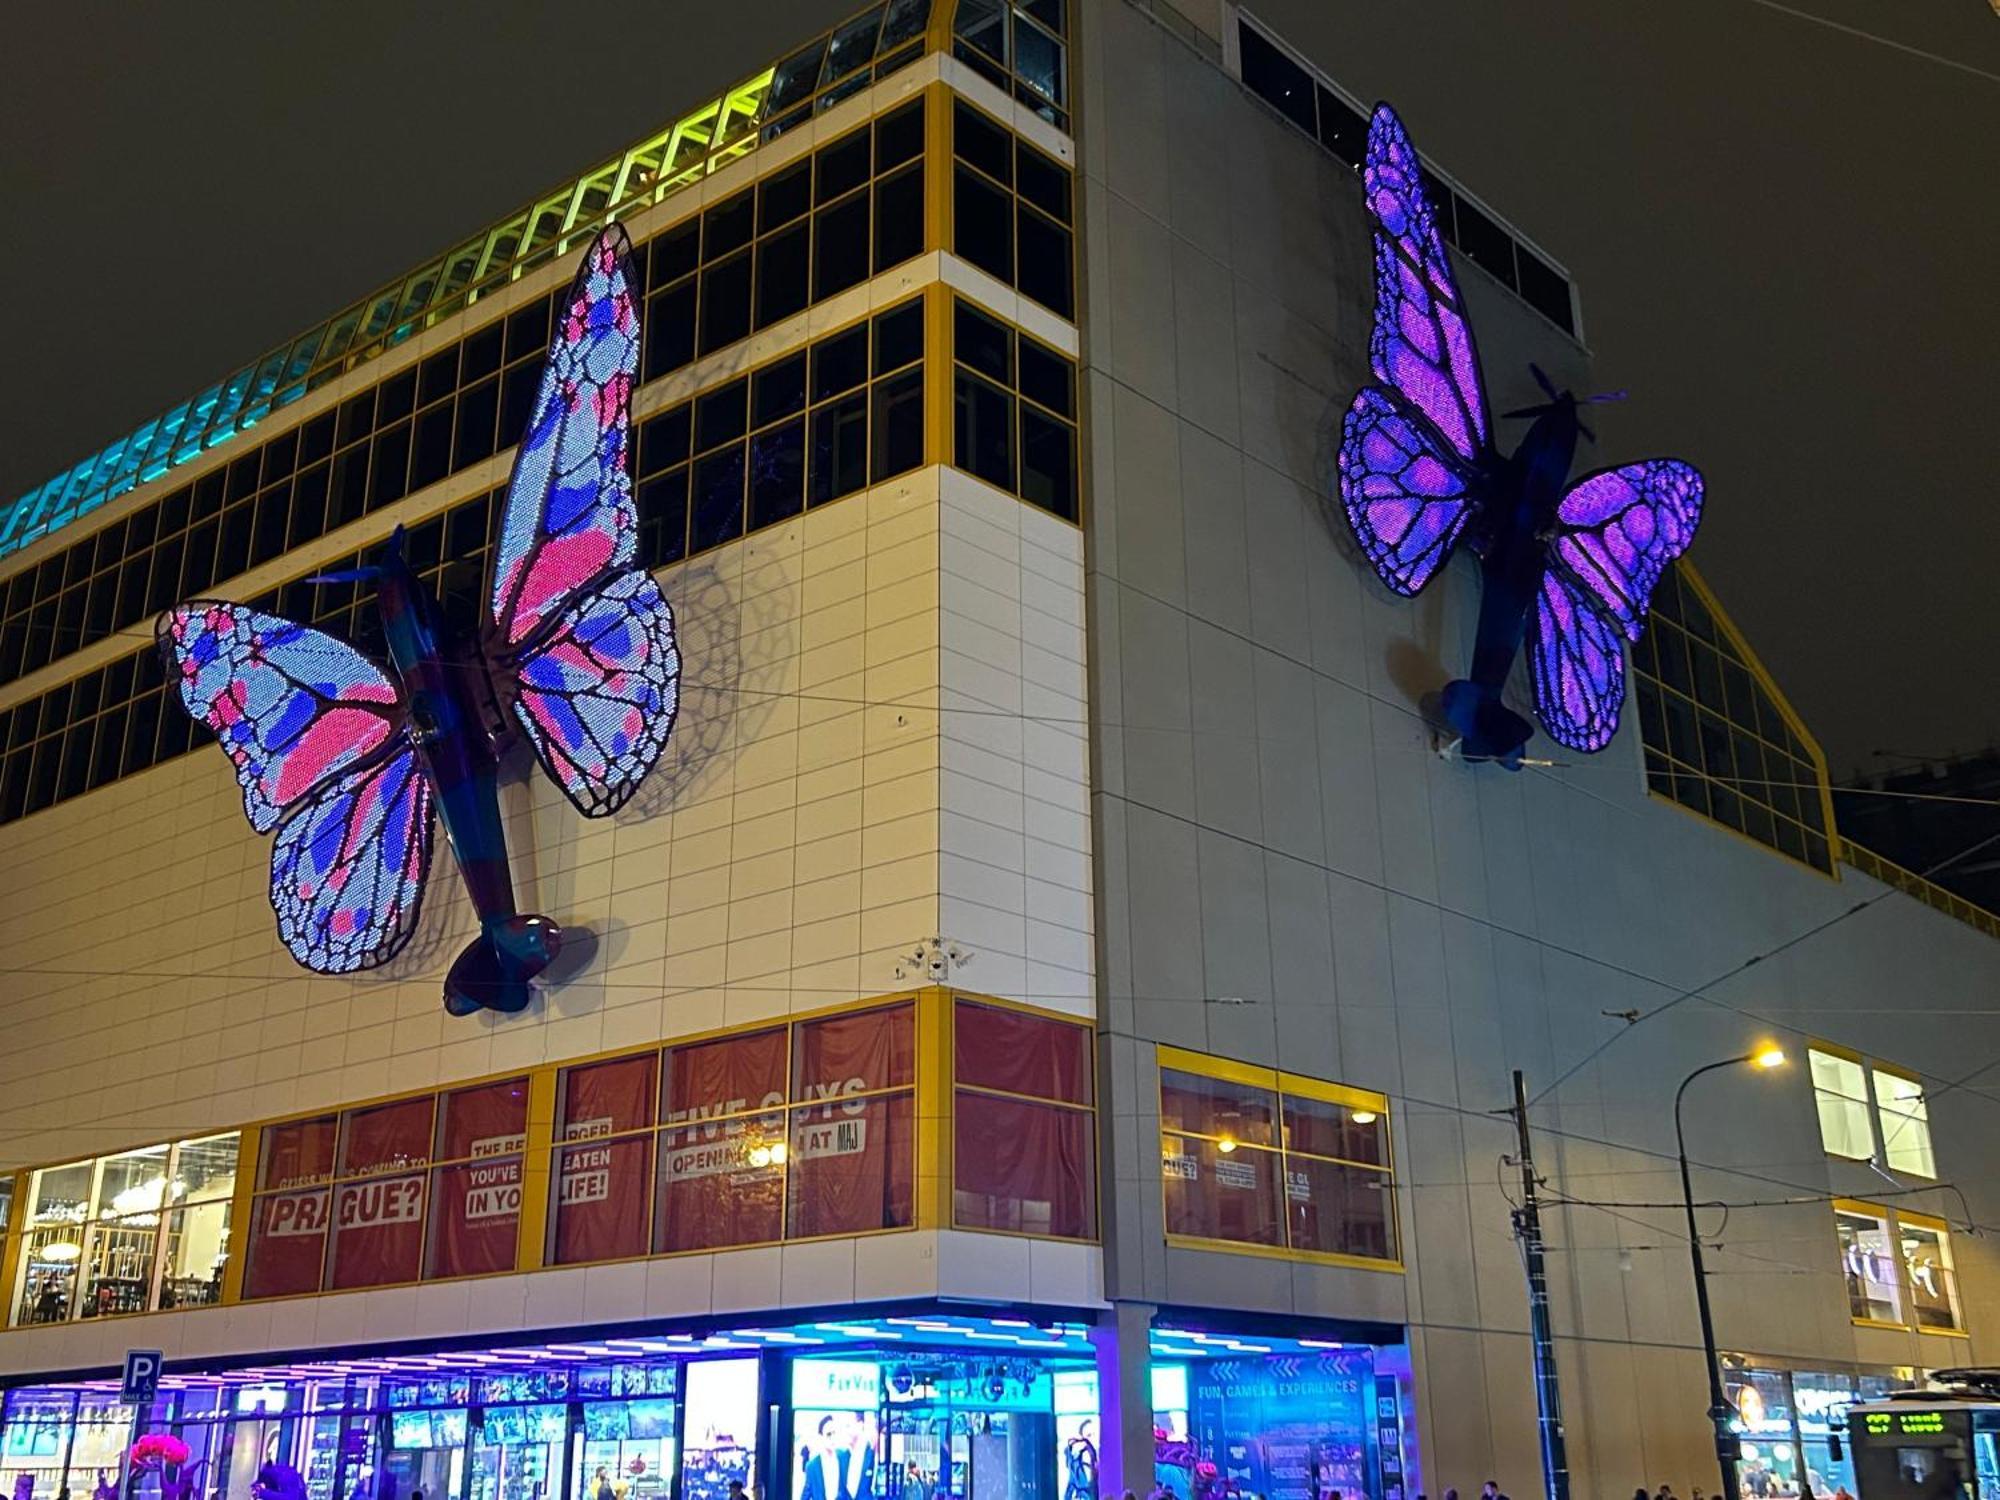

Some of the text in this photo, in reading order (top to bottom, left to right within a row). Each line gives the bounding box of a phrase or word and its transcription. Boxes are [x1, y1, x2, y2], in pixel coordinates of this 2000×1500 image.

[667, 1098, 747, 1147] FIVE
[473, 1142, 502, 1157] THE
[672, 1143, 748, 1174] OPENIN
[809, 1130, 833, 1150] AT
[469, 1149, 611, 1185] YOU'VE EATEN
[468, 1191, 488, 1214] IN
[495, 1188, 521, 1211] YO
[131, 1357, 153, 1388] P
[1279, 1379, 1358, 1396] EXPERIENCES
